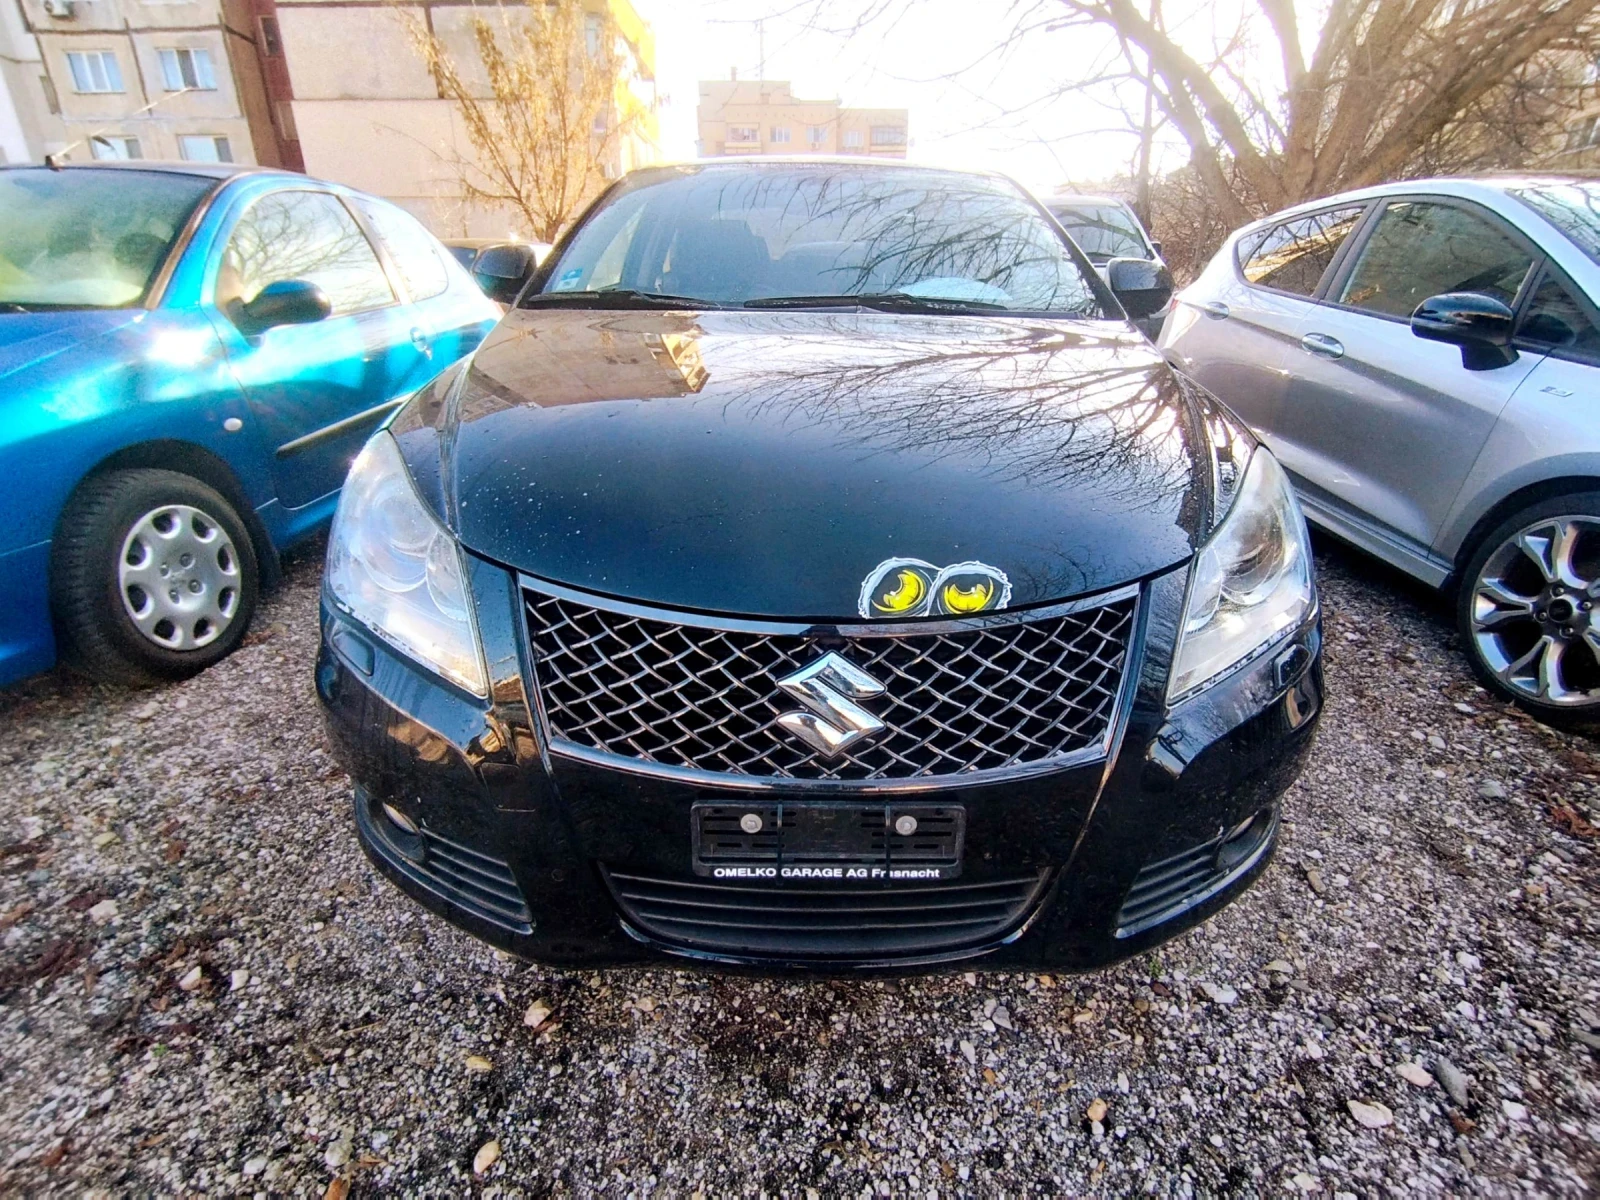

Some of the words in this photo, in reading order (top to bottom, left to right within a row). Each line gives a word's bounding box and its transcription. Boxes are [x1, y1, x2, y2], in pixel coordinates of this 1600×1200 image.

[713, 867, 777, 878] OMELKO
[780, 867, 843, 878] GARAGE
[845, 867, 868, 878] AG
